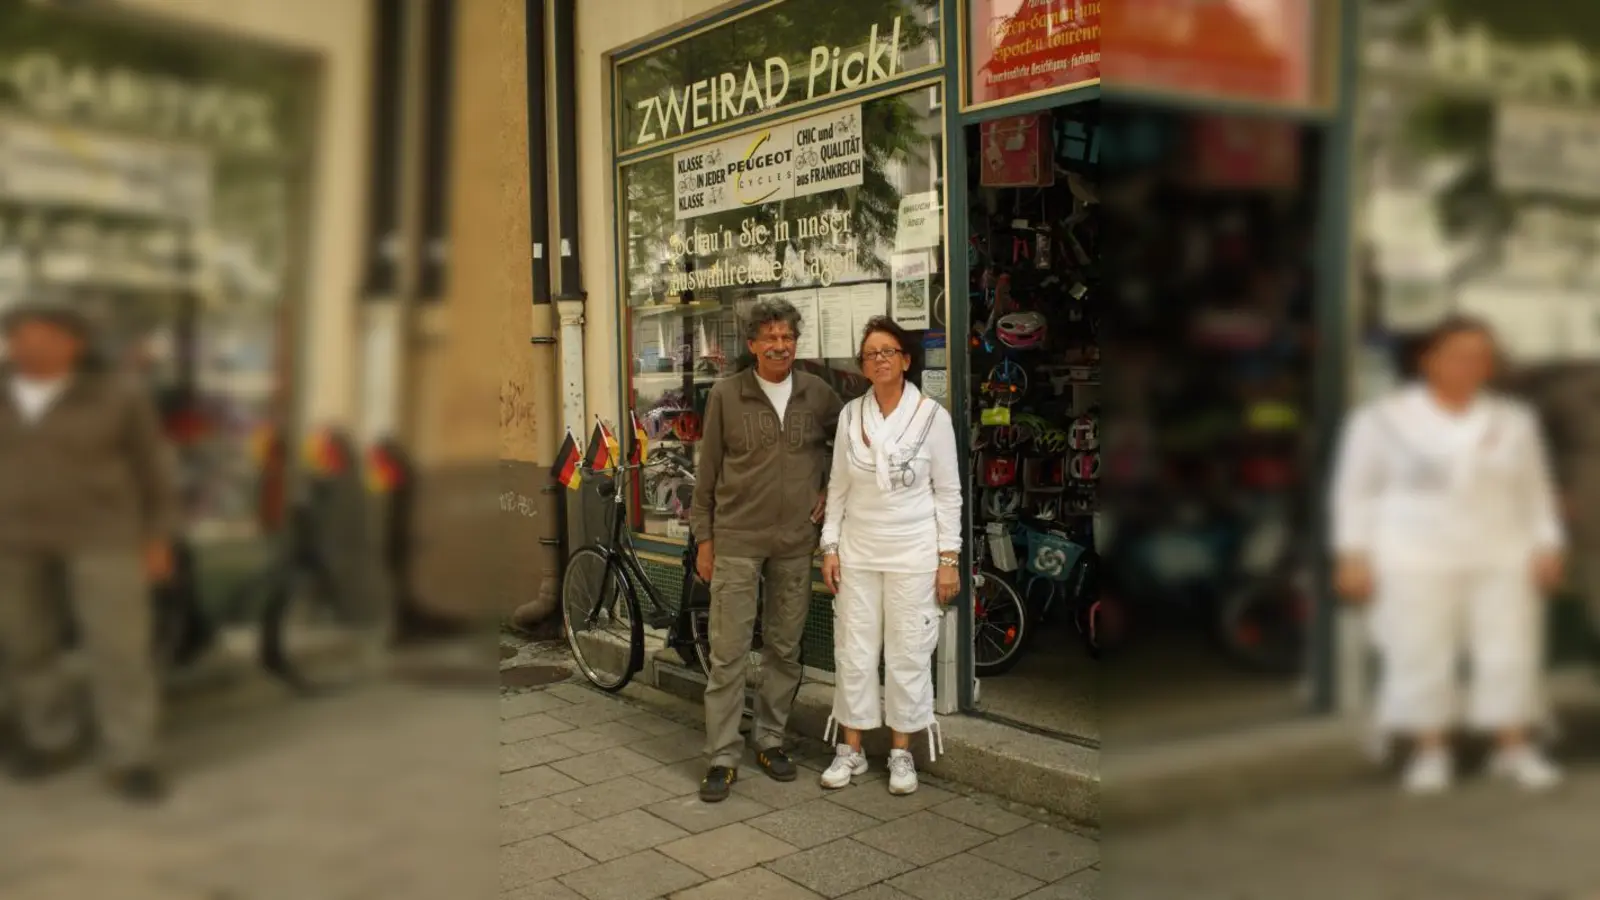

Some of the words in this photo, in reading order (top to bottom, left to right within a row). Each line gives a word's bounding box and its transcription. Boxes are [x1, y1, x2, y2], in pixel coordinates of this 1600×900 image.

[637, 56, 790, 145] ZWEIRAD
[807, 16, 902, 100] Pickl
[797, 130, 816, 146] CHIC
[818, 123, 834, 142] und
[820, 135, 861, 160] QUALITÄT
[677, 154, 704, 174] KLASSE
[727, 149, 793, 175] PEUGEOT
[796, 174, 810, 187] aus
[810, 159, 861, 184] FRANKREICH
[696, 174, 704, 189] IN
[705, 168, 726, 187] JEDER
[739, 170, 793, 189] CYCLES
[678, 192, 705, 212] KLASSE
[739, 218, 770, 247] Sie
[774, 213, 789, 242] in
[798, 210, 853, 239] unser
